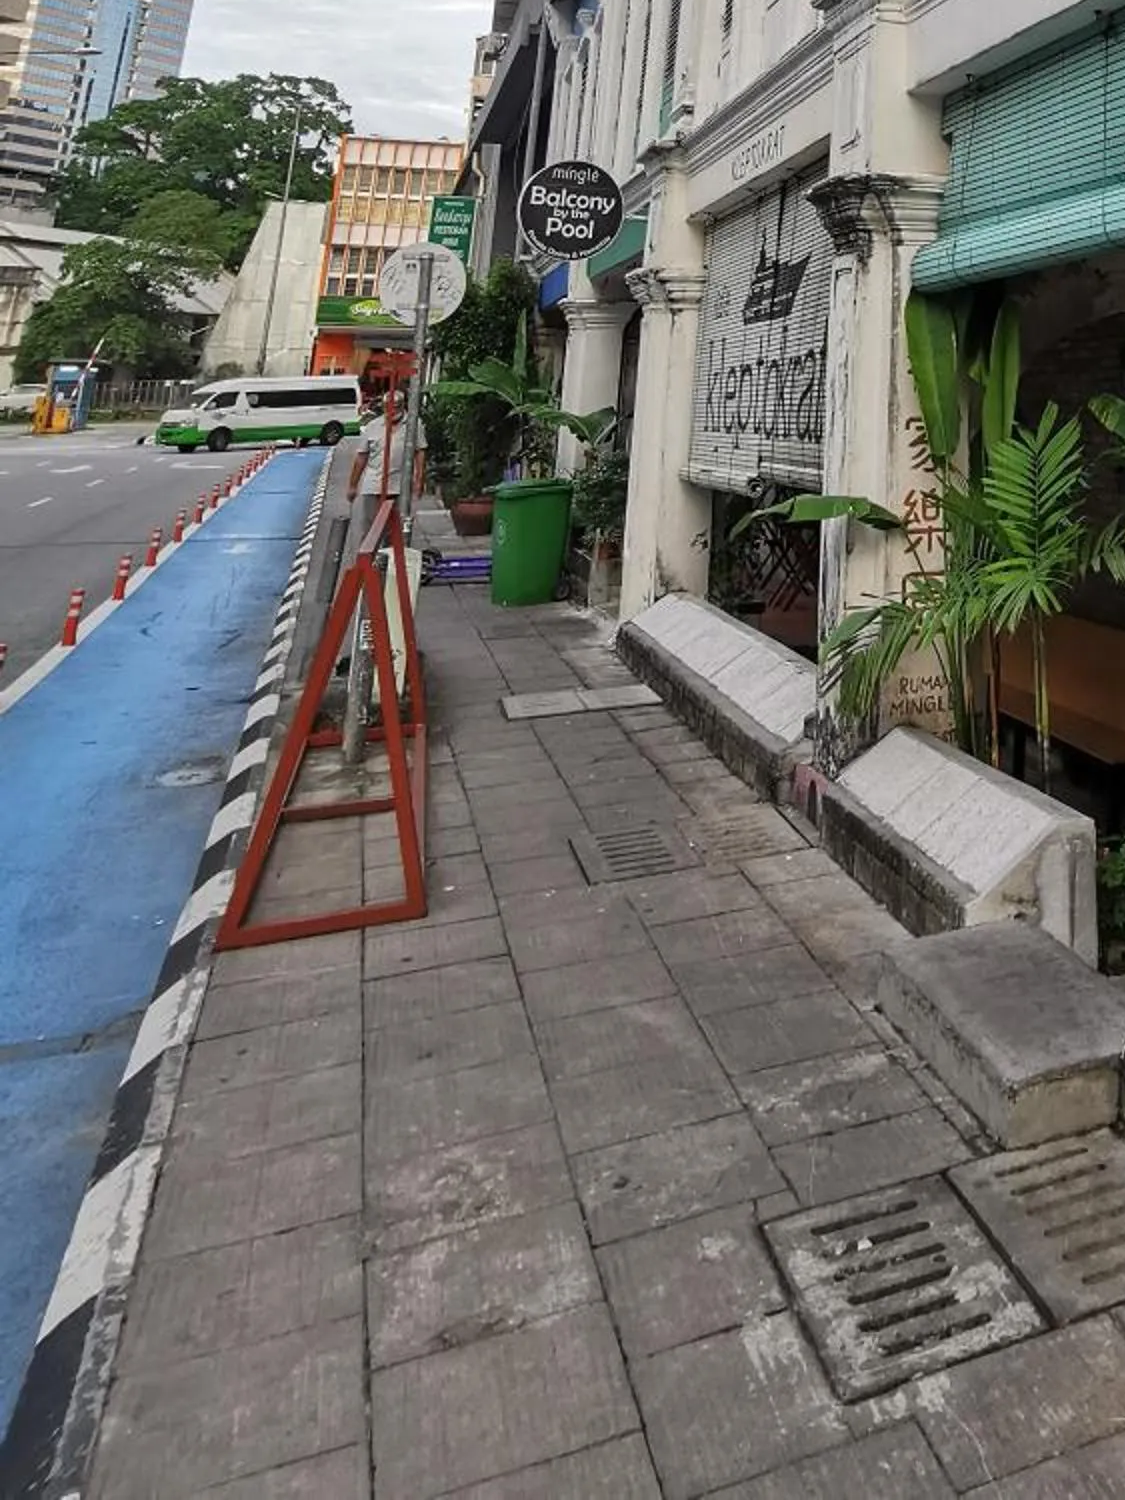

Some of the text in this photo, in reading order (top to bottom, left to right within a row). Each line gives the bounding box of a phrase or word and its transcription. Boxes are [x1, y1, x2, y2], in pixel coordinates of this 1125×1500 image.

[529, 185, 616, 216] Balcony
[552, 206, 591, 220] by the
[545, 217, 595, 240] Pool
[898, 674, 953, 695] RUMA
